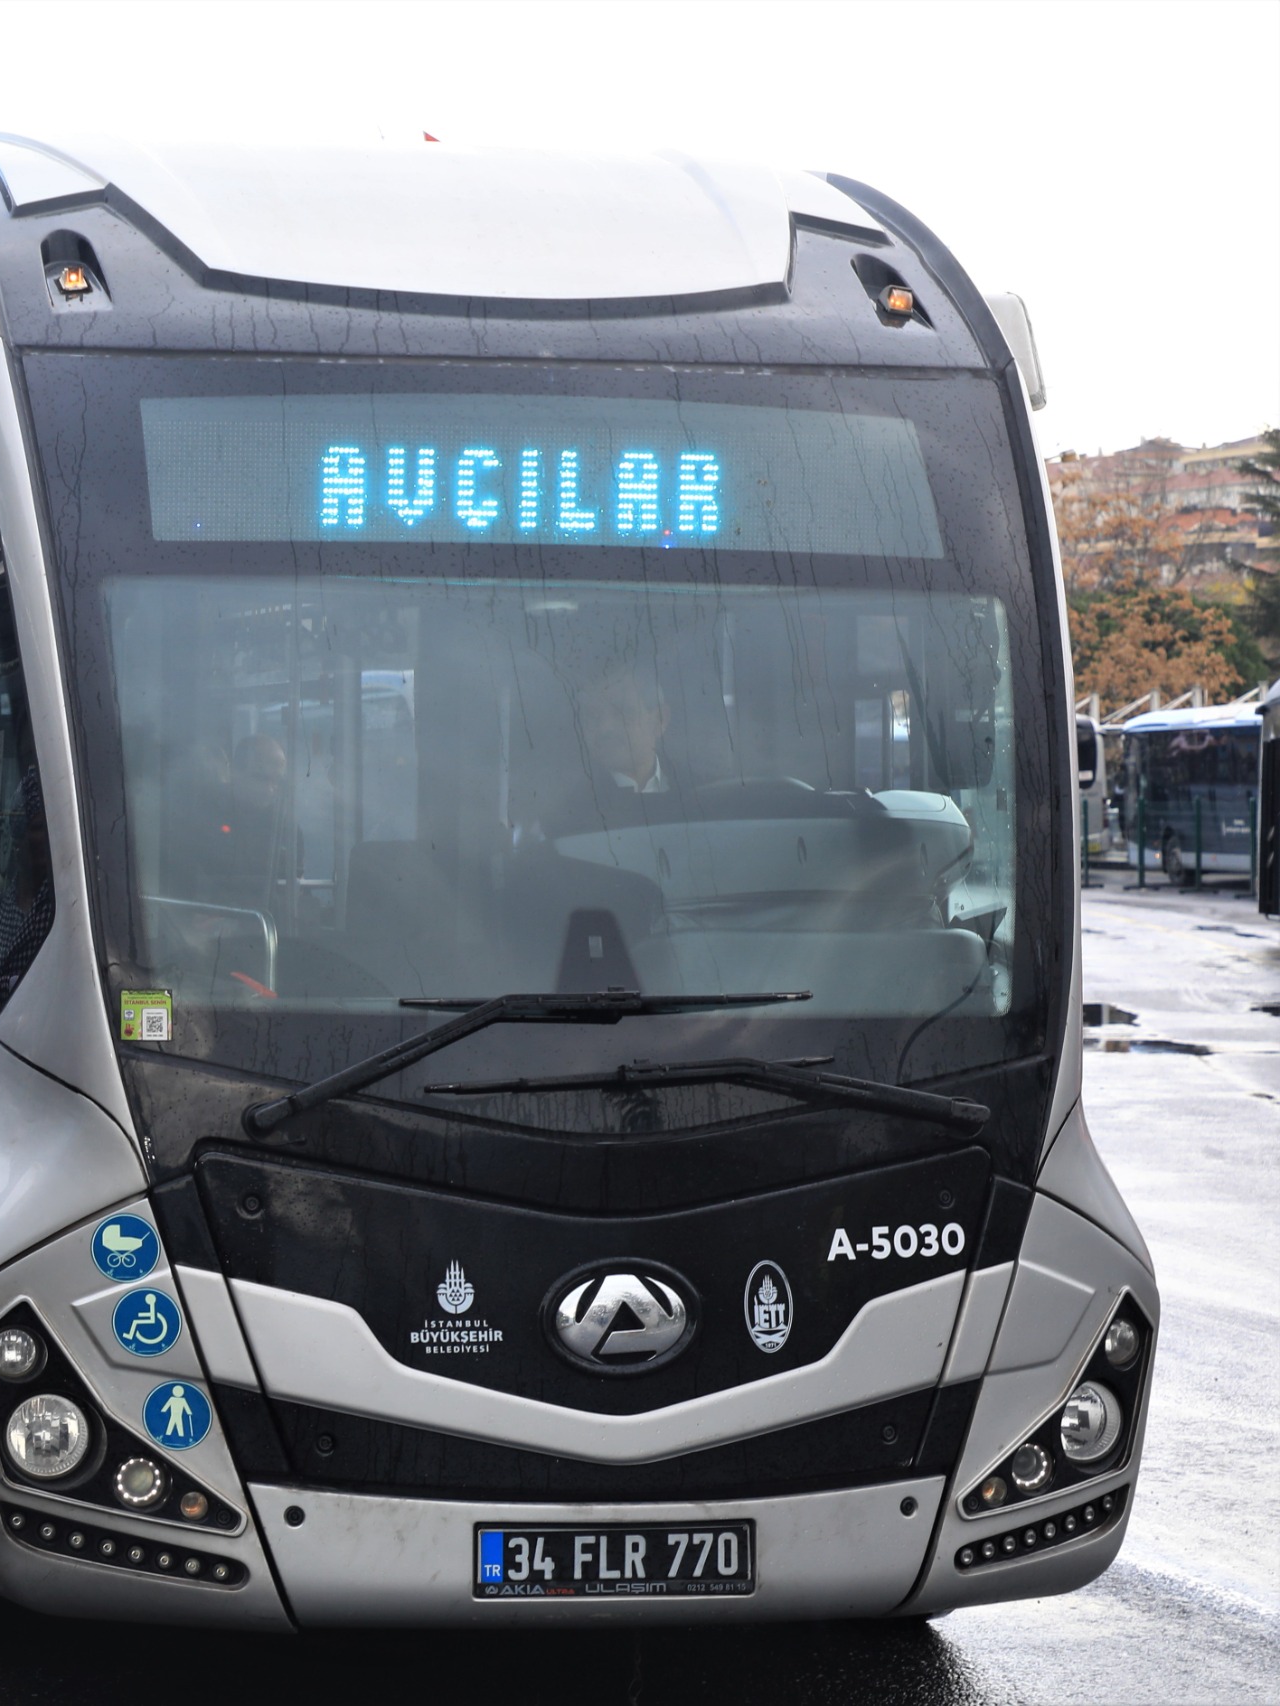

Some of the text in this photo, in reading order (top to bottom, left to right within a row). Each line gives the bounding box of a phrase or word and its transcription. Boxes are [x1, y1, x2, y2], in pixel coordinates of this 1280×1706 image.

[321, 444, 719, 531] AVCILAR
[827, 1222, 966, 1262] A-5030
[424, 1319, 489, 1328] İSTANBUL
[410, 1328, 503, 1343] BÜYÜKŞEHİR
[425, 1343, 489, 1354] BELEDİYESİ
[507, 1532, 739, 1580] 34 FLR 770
[484, 1564, 501, 1577] TR
[500, 1584, 545, 1595] AKIA
[585, 1582, 667, 1594] ULAŞIM
